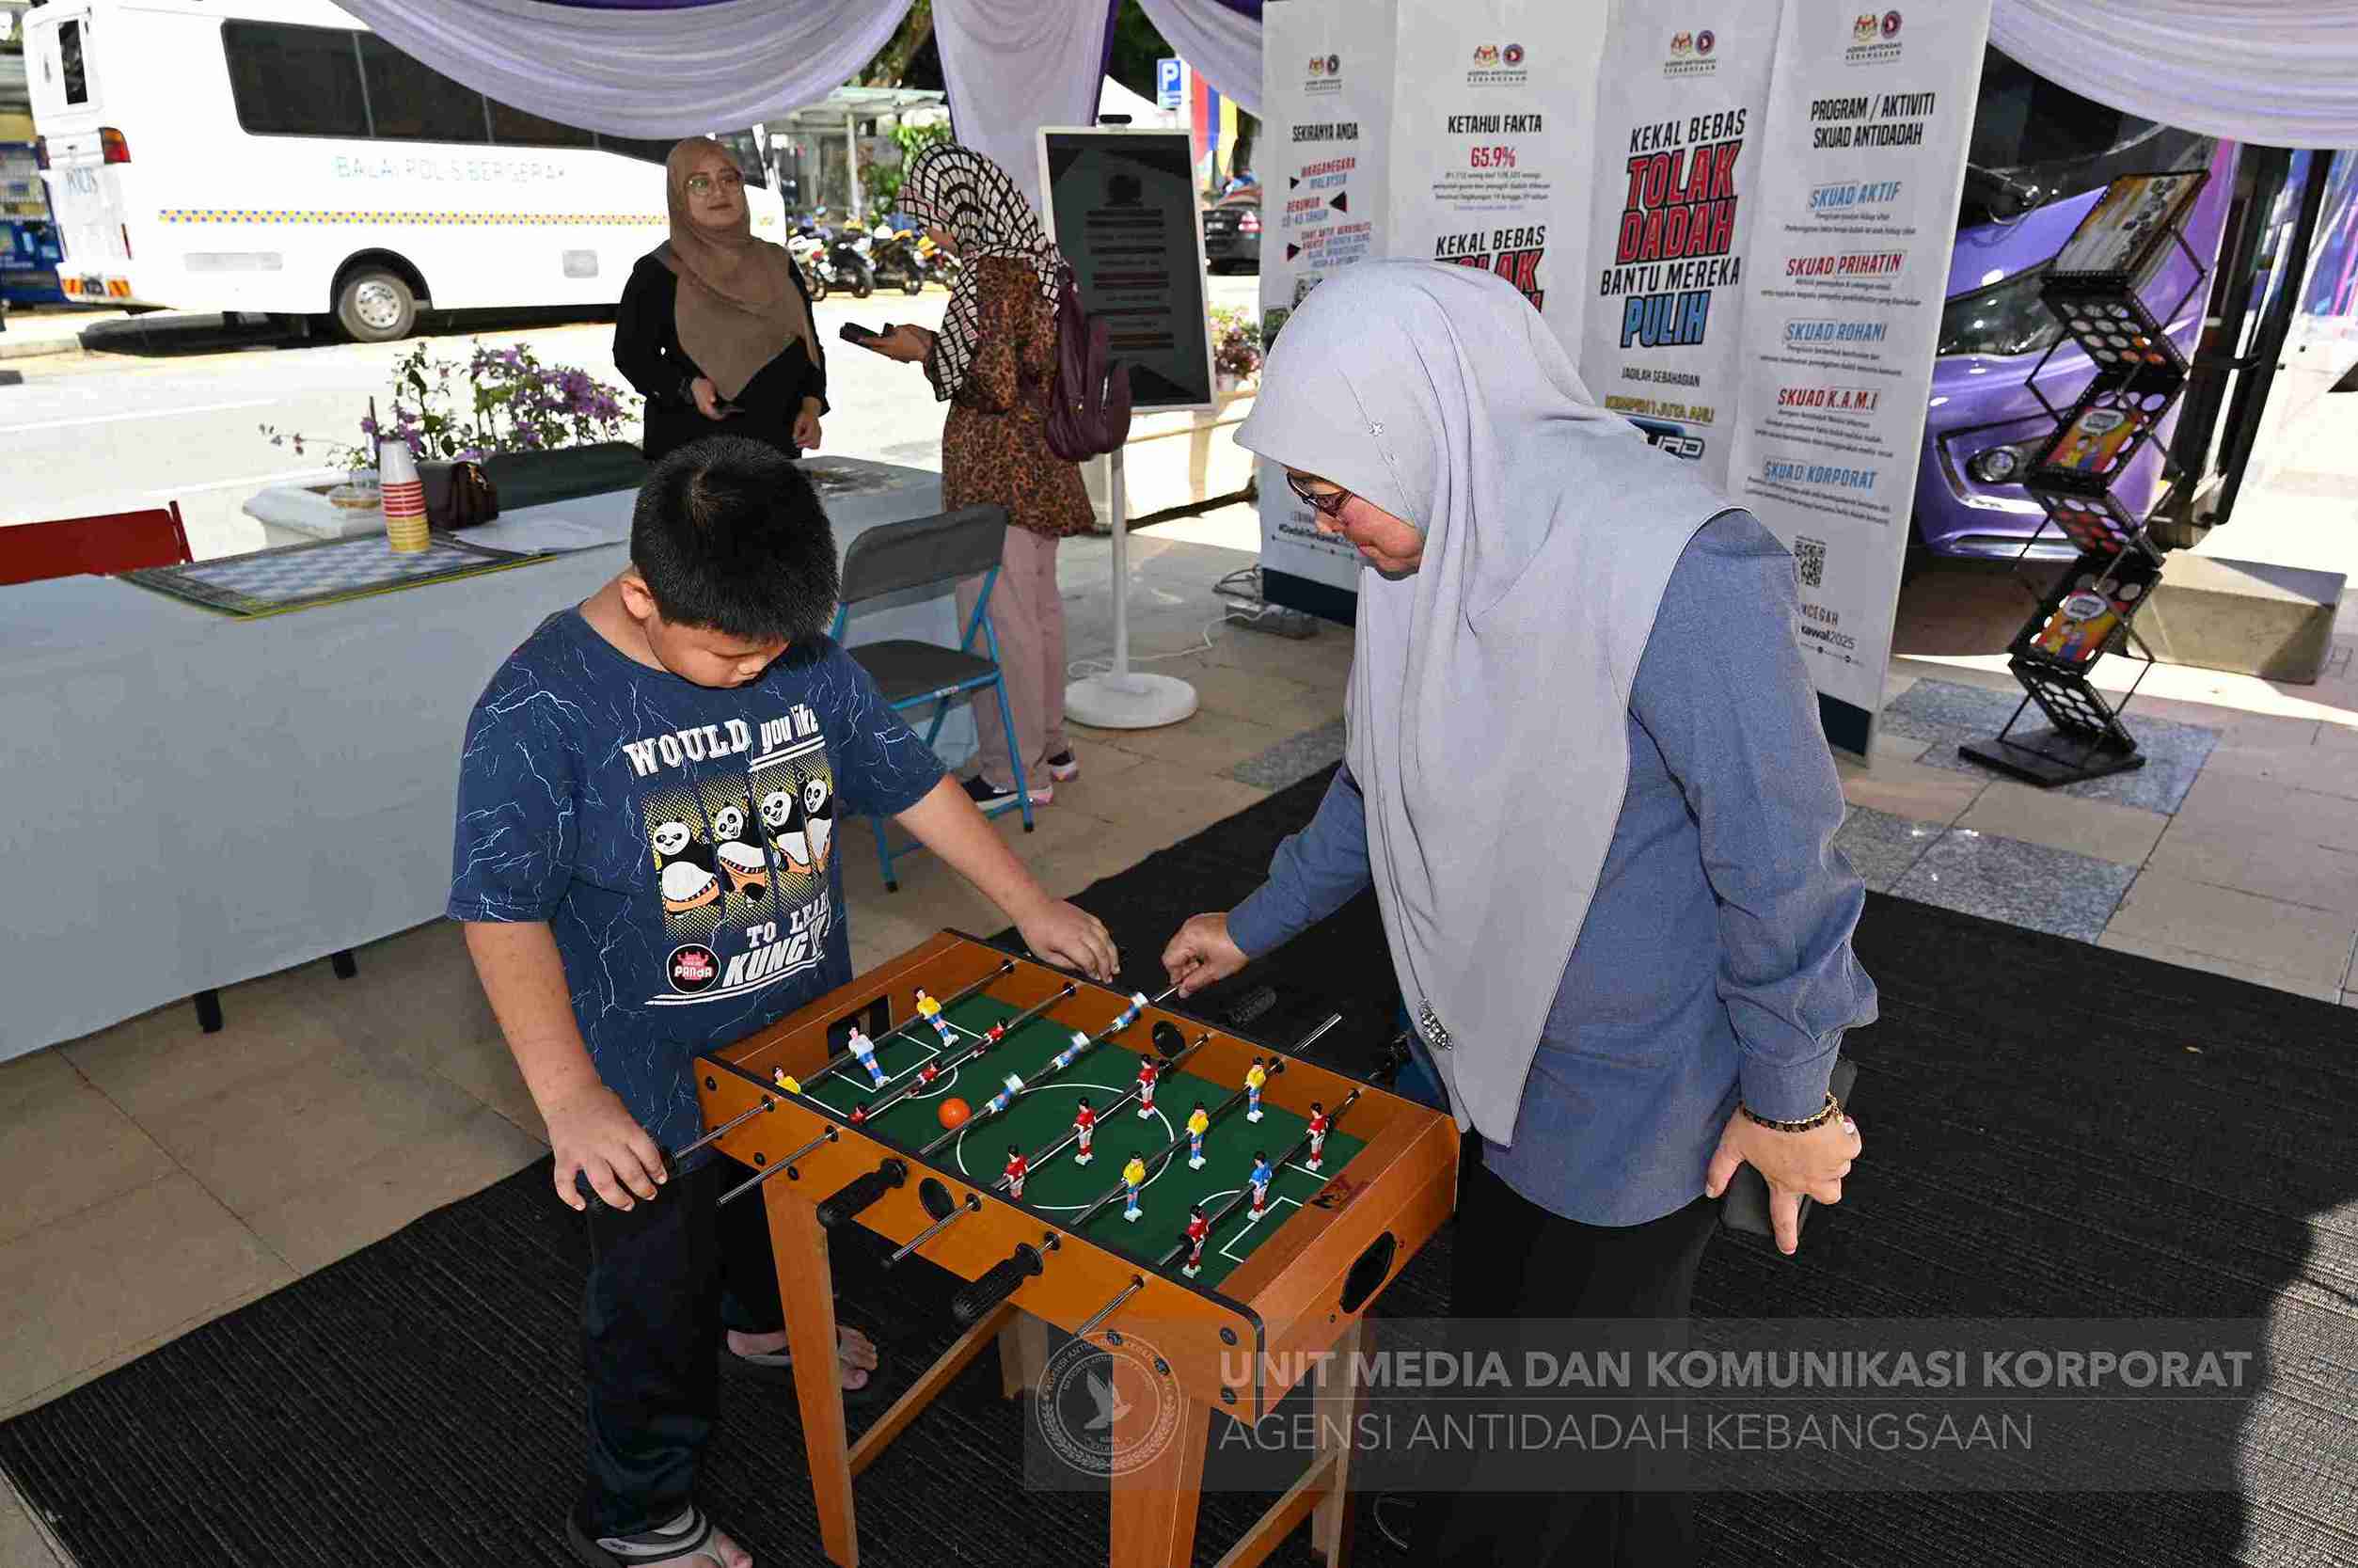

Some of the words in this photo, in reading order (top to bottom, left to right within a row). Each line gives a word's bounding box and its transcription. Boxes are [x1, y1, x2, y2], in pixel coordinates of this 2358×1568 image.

[1163, 62, 1179, 90] P
[1811, 97, 1868, 120] PROGRAM
[1869, 94, 1881, 122] /
[1881, 92, 1935, 117] AKTIVITI
[1336, 122, 1358, 140] ANDA
[1448, 115, 1501, 134] KETAHUI
[1504, 114, 1542, 133] FAKTA
[1629, 120, 1682, 152] KEKAL
[1687, 108, 1747, 143] BEBAS
[1813, 126, 1852, 149] SKUAD
[1853, 122, 1923, 147] ANTIDADAH
[405, 158, 459, 181] POLS
[1470, 146, 1516, 167] 65.9%
[1626, 139, 1743, 212] TOLAK
[1810, 186, 1856, 208] SKUAD
[1857, 181, 1902, 204] AKTIF
[1435, 232, 1486, 257] KEKAL
[1492, 225, 1546, 250] BEBAS
[1615, 196, 1737, 265] DADAH
[1600, 264, 1661, 296] BANTU
[1665, 257, 1741, 290] MEREKA
[1786, 257, 1835, 276] SKUAD
[1836, 253, 1901, 274] PRIHATIN
[1620, 290, 1712, 349] PULIH
[1785, 323, 1834, 341] SKUAD
[1835, 323, 1887, 341] ROHANI
[1621, 366, 1653, 382] JADILAH
[1653, 370, 1701, 388] SEBAHAGIAN
[1778, 388, 1825, 406] SKUAD
[1765, 461, 1805, 482] SKUAD
[1805, 467, 1877, 489] KORPORAT
[622, 719, 753, 777] WOULD
[760, 715, 792, 753] you
[791, 704, 819, 737] like
[747, 921, 777, 949] TO
[722, 931, 810, 988] KUNG
